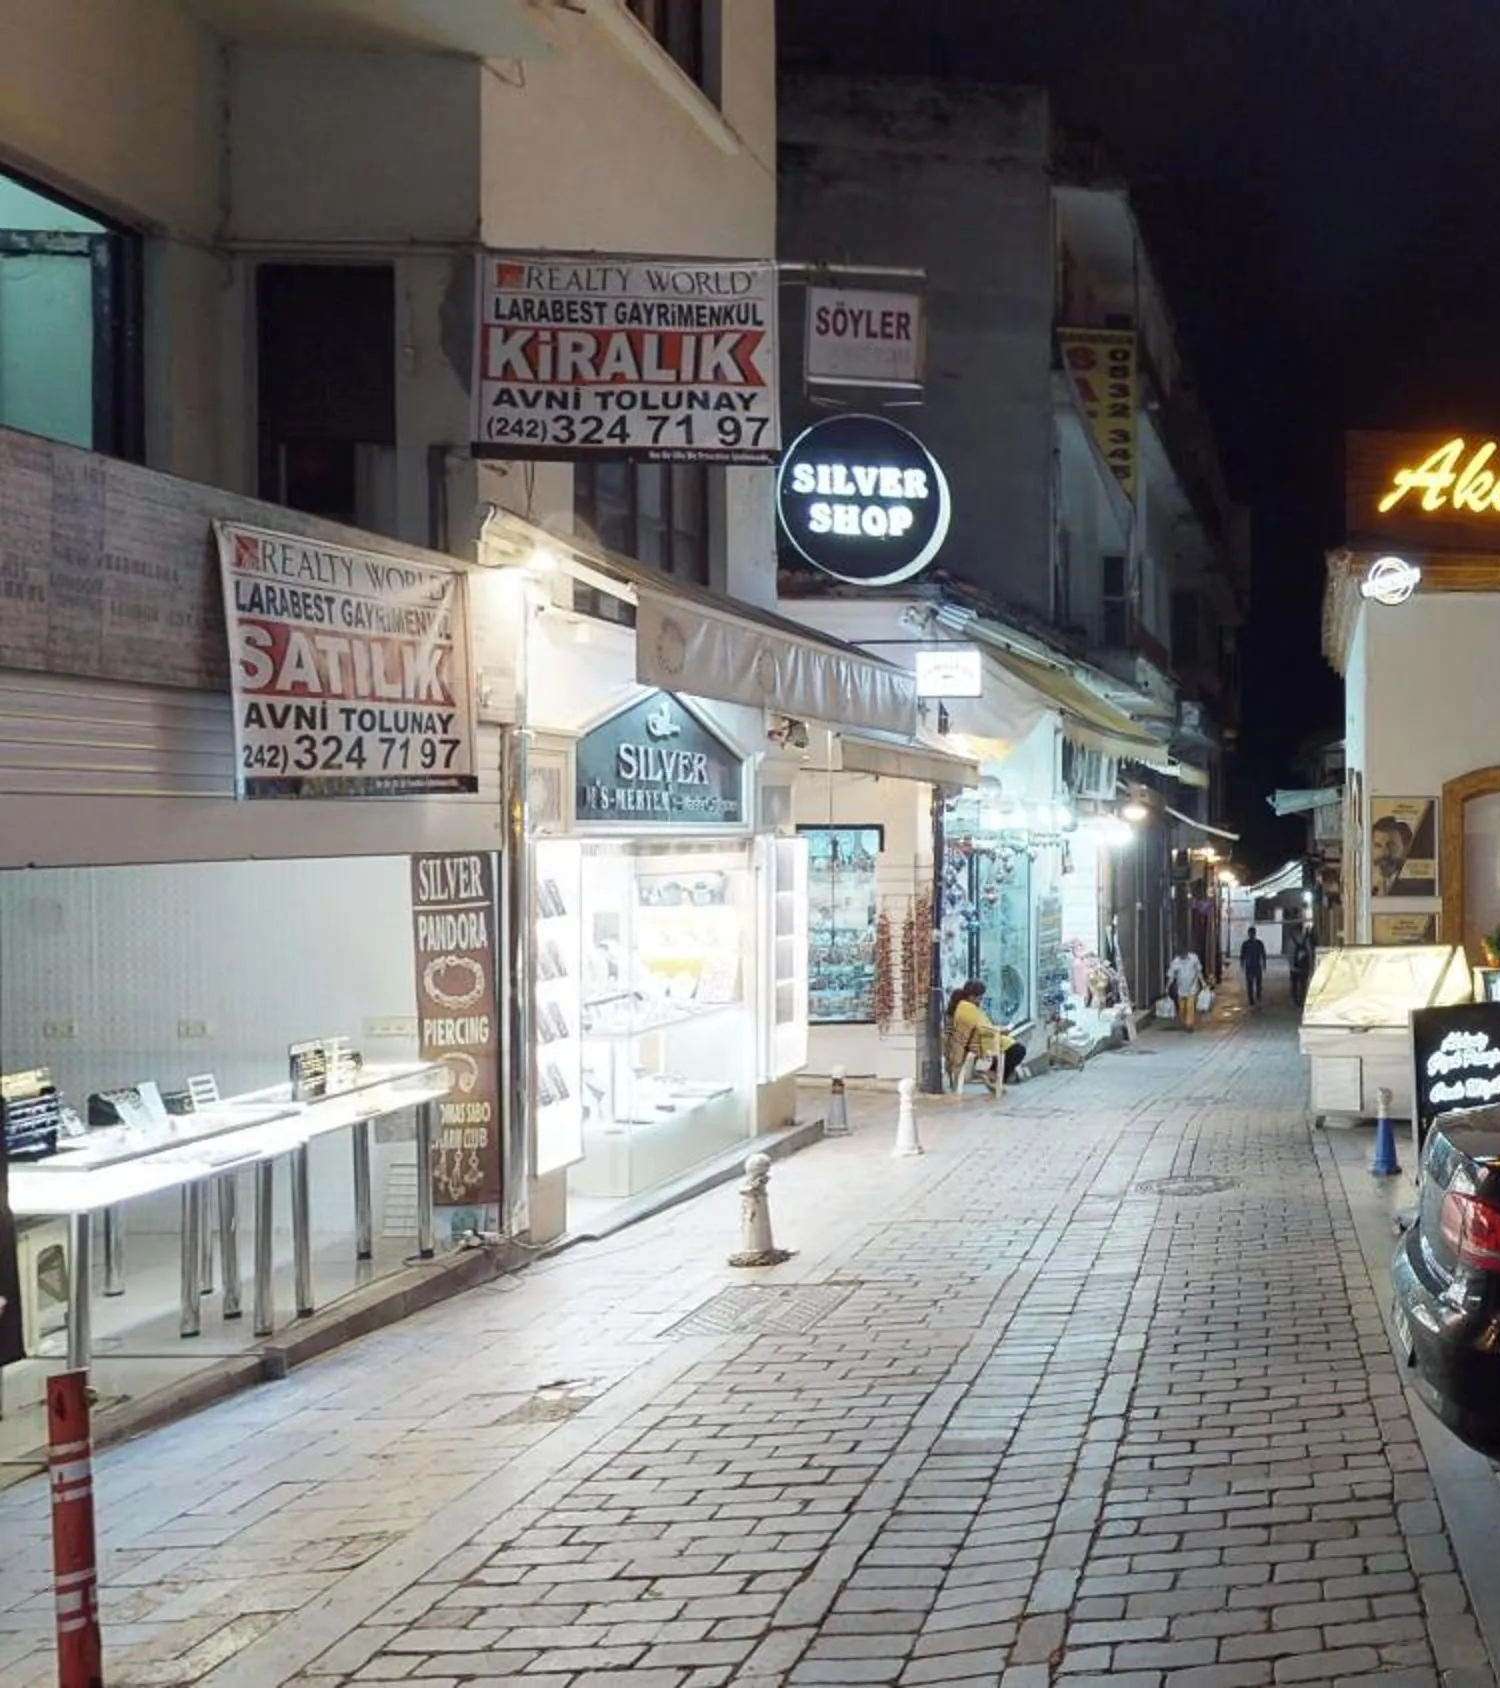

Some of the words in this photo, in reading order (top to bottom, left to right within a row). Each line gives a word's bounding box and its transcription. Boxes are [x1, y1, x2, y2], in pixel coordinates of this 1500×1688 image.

[527, 264, 631, 291] REALTY
[494, 298, 607, 325] LARABEST
[815, 299, 912, 341] SÖYLER
[492, 386, 582, 411] AVNİ
[594, 390, 758, 411] TOLUNAY
[486, 416, 547, 442] (242)
[551, 414, 631, 445] 324
[646, 415, 694, 445] 71
[716, 415, 770, 447] 97
[791, 462, 930, 499] SILVER
[808, 502, 914, 537] SHOP
[261, 540, 354, 586] REALTY
[234, 580, 338, 625] LARABEST
[238, 625, 450, 702] SATILIK
[244, 700, 328, 732] AVNİ
[339, 707, 455, 735] TOLUNAY
[293, 733, 367, 771] 324
[378, 737, 411, 770] 71
[419, 738, 462, 770] 97
[619, 742, 710, 786] SILVER
[418, 855, 485, 901] SILVER
[417, 911, 489, 951] PANDORA
[423, 1015, 490, 1048] PIERCING
